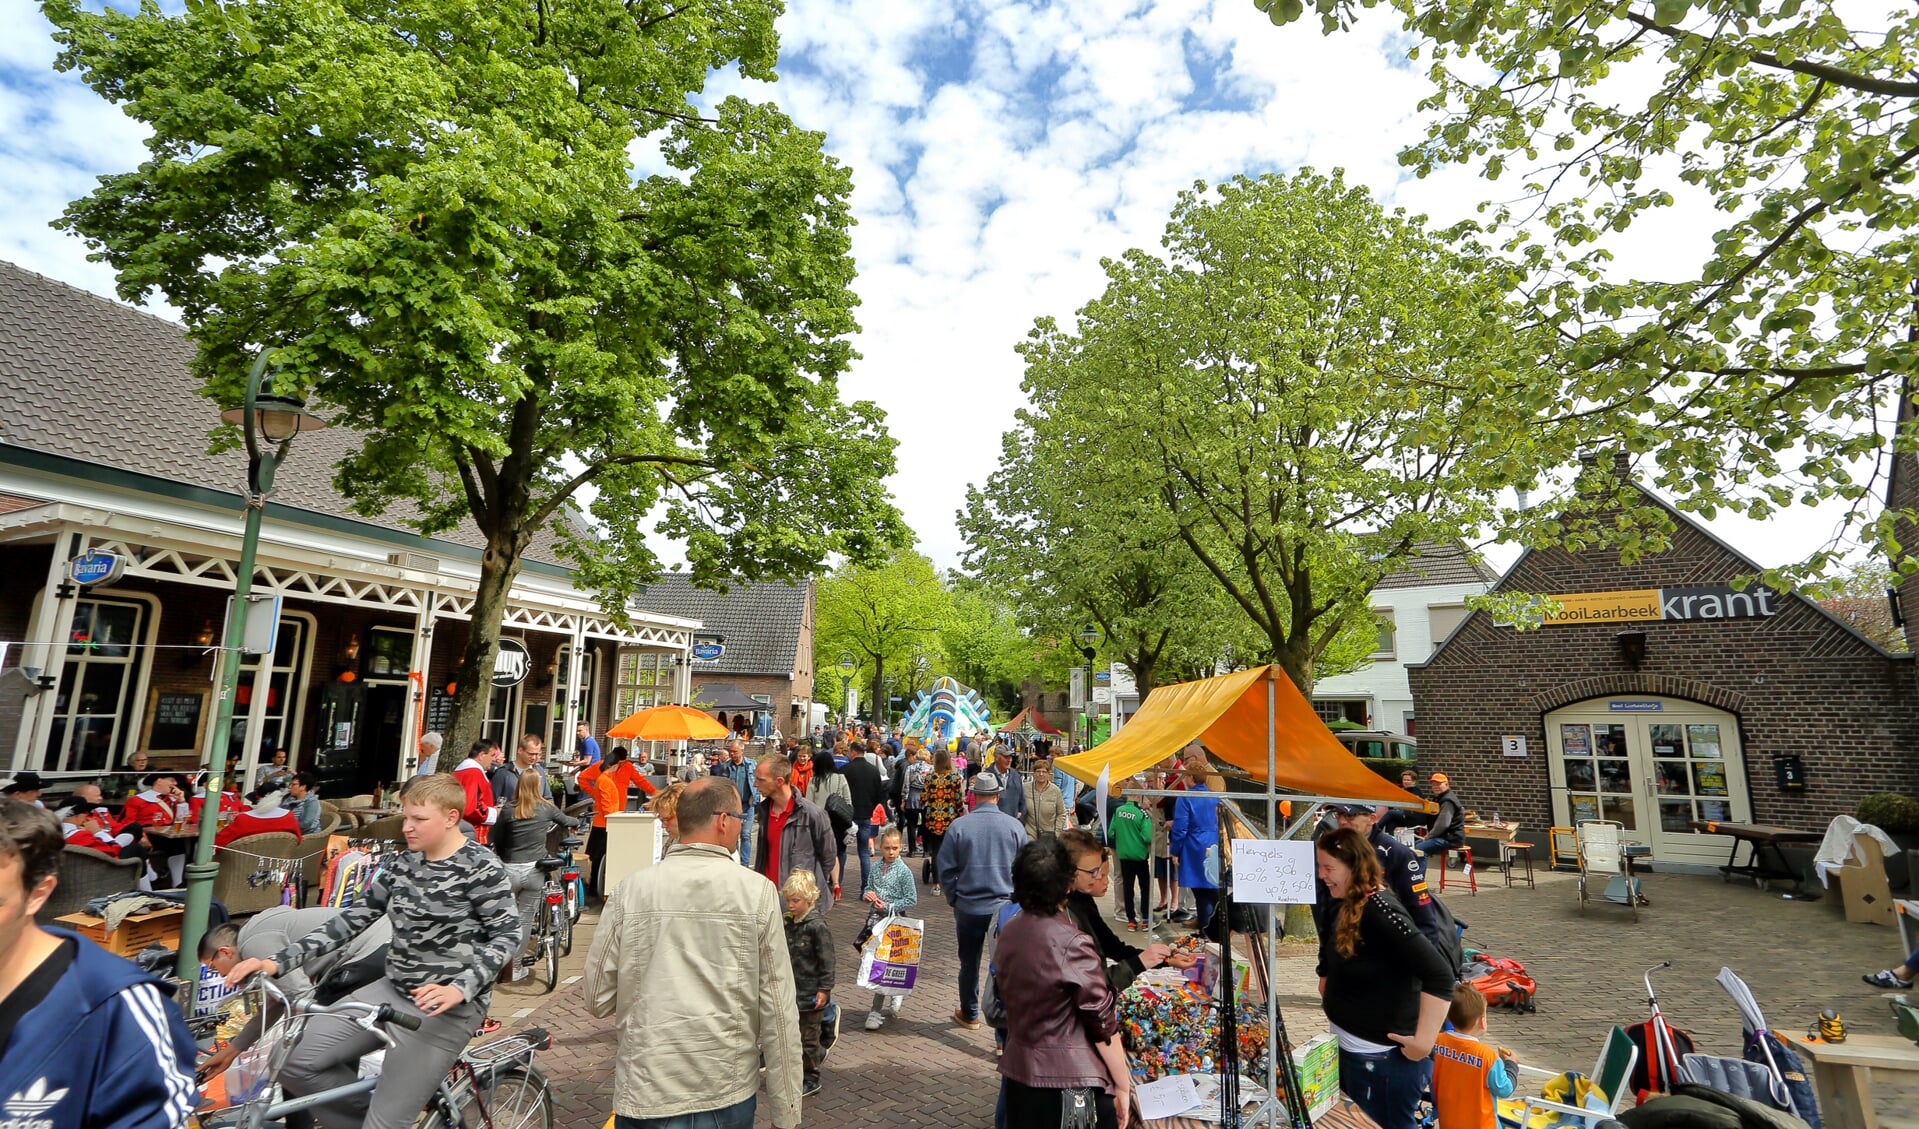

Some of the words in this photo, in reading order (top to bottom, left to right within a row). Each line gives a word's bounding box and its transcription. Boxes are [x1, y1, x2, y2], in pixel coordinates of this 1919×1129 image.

[74, 561, 107, 575] Bavaria
[1659, 587, 1776, 620] krant
[1510, 740, 1518, 750] 3
[1786, 771, 1793, 780] 3
[1235, 843, 1283, 863] Hengels
[1235, 867, 1267, 882] 20%
[1275, 857, 1296, 878] 30%
[1265, 880, 1287, 897] 40%
[1292, 873, 1312, 892] 50%
[1433, 1044, 1483, 1069] HOLLAND
